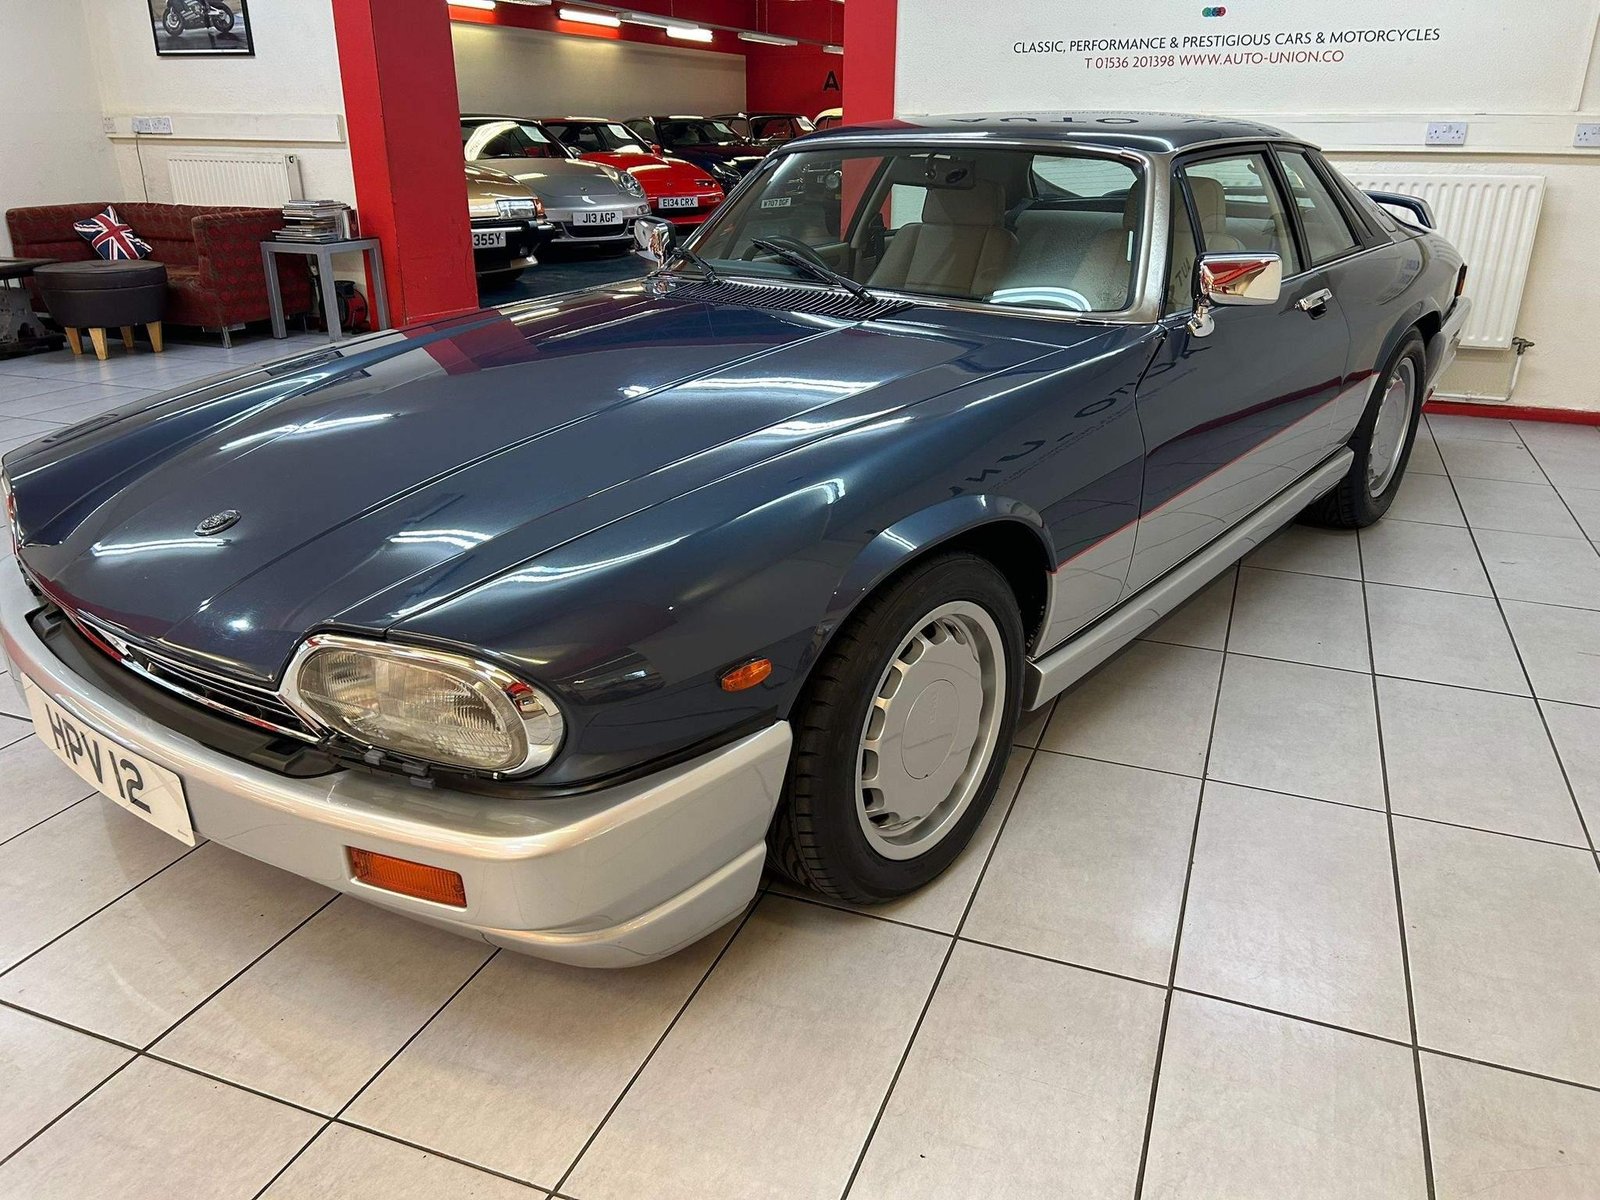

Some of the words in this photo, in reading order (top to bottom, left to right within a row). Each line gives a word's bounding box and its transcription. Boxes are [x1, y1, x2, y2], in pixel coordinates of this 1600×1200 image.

[1013, 41, 1066, 54] CLASSIC,
[1069, 37, 1166, 52] PERFORMANCE
[1169, 37, 1179, 48] &
[1182, 33, 1271, 48] PRESTIGIOUS
[1275, 32, 1312, 45] CARS
[1315, 31, 1325, 44] &
[1329, 28, 1440, 43] MOTORCYCLES
[1085, 58, 1093, 69] T
[1095, 56, 1129, 69] 01536
[1132, 55, 1175, 68] 201398
[1179, 50, 1344, 66] WWW.AUTO-UNION.CO
[823, 70, 840, 91] A
[662, 198, 679, 207] E134
[680, 198, 694, 206] CRX
[582, 213, 597, 223] J13
[600, 212, 616, 223] AGP
[473, 232, 501, 246] 355Y
[45, 703, 103, 784] HPV
[108, 750, 152, 814] 12
